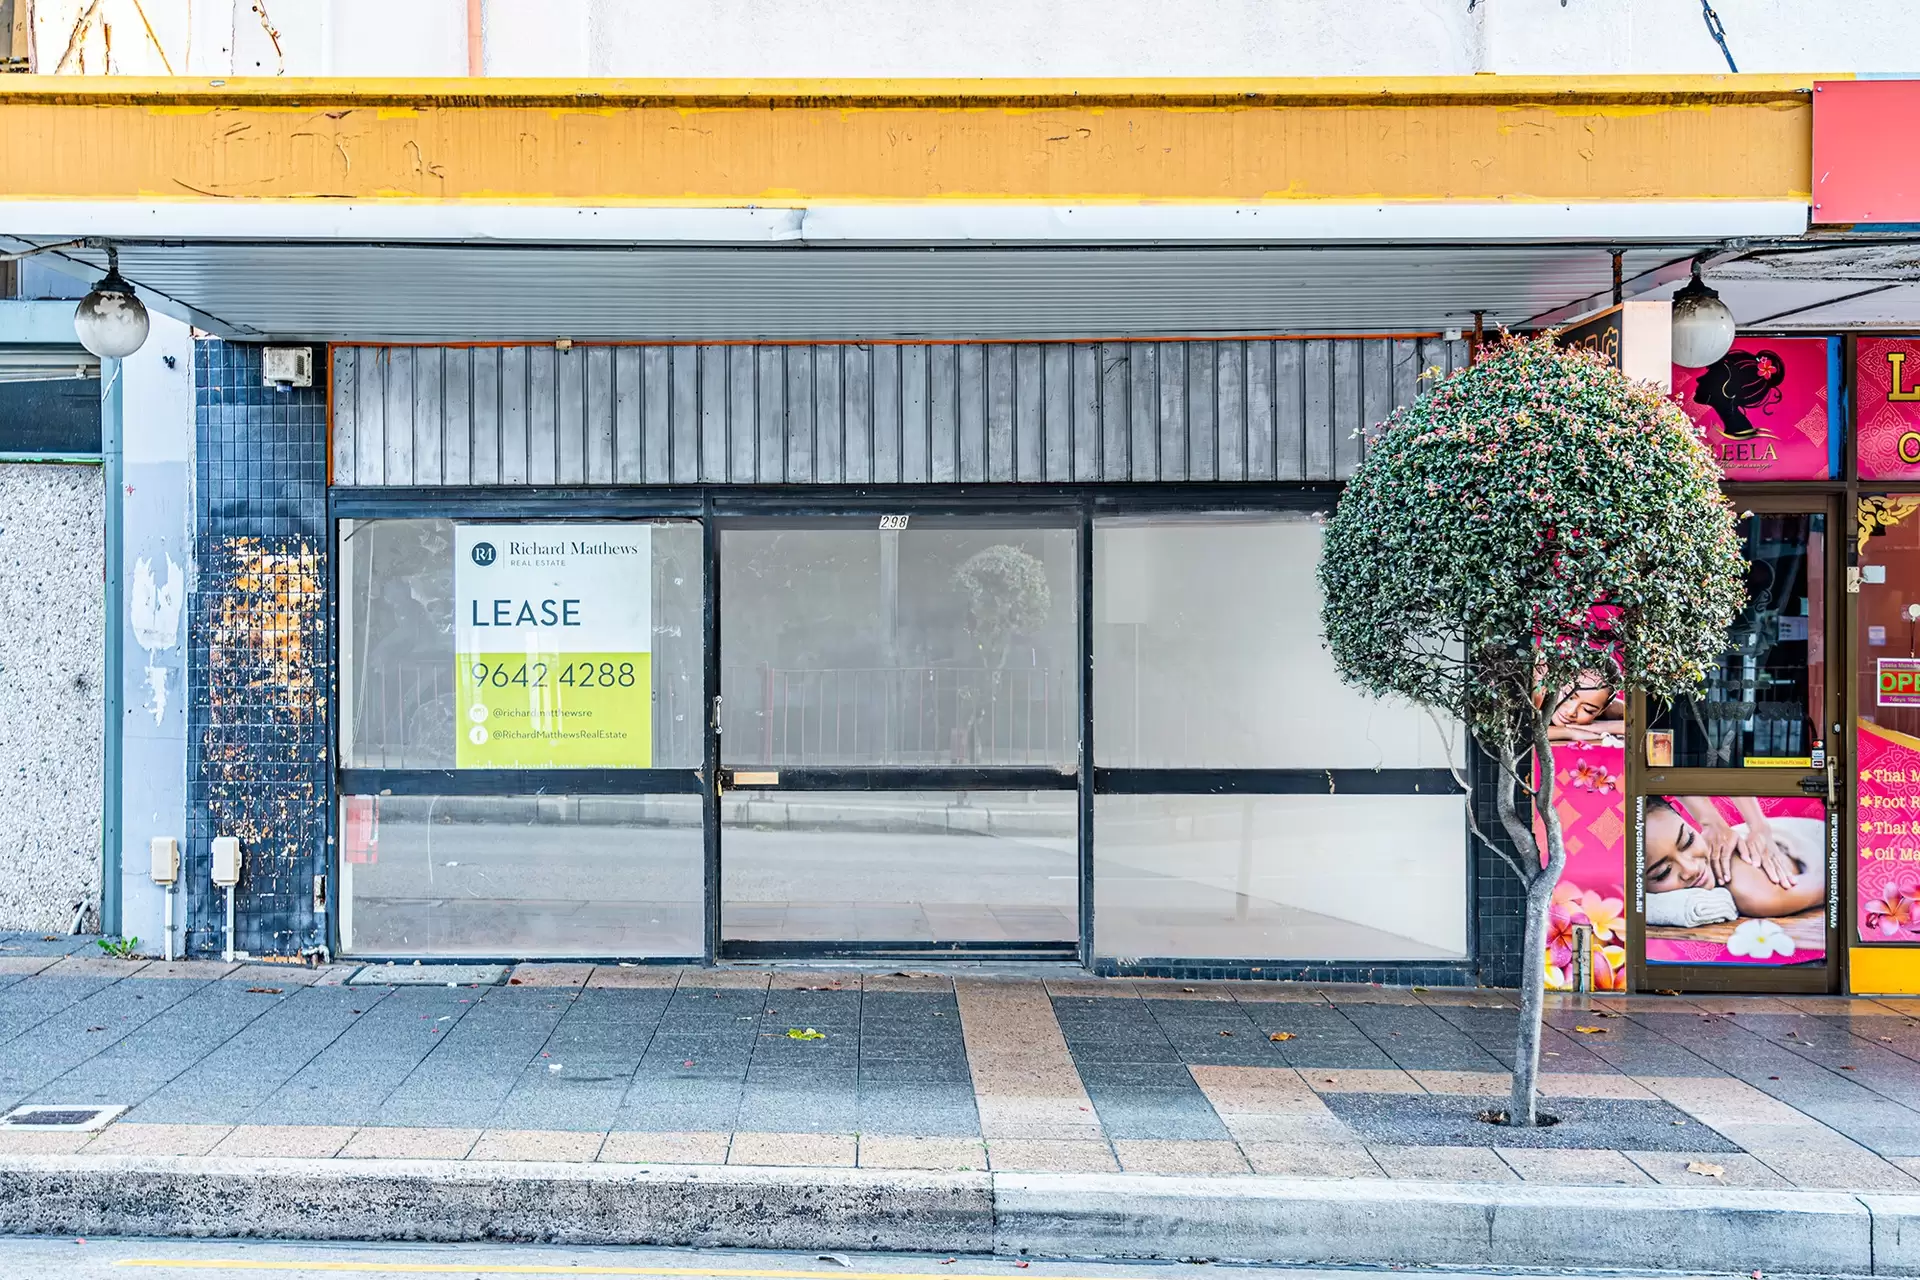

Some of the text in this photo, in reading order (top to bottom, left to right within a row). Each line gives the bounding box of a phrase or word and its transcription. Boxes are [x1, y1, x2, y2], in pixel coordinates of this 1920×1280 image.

[1887, 353, 1920, 401] L
[881, 516, 907, 528] 298
[510, 541, 565, 555] Richard
[571, 541, 638, 555] Matthews
[510, 559, 566, 567] REAL ESTATE
[472, 599, 581, 626] LEASE
[472, 662, 635, 688] 9642 4288
[493, 730, 628, 740] @RichardMatthewsRealEstate
[1874, 769, 1905, 782] Thai
[1874, 796, 1906, 808] Foot
[1874, 821, 1907, 834] Thai
[1635, 796, 1644, 913] www.lycamobile.com.au
[1875, 847, 1895, 860] Oil
[1829, 814, 1838, 929] www.lycamobile.com.au
